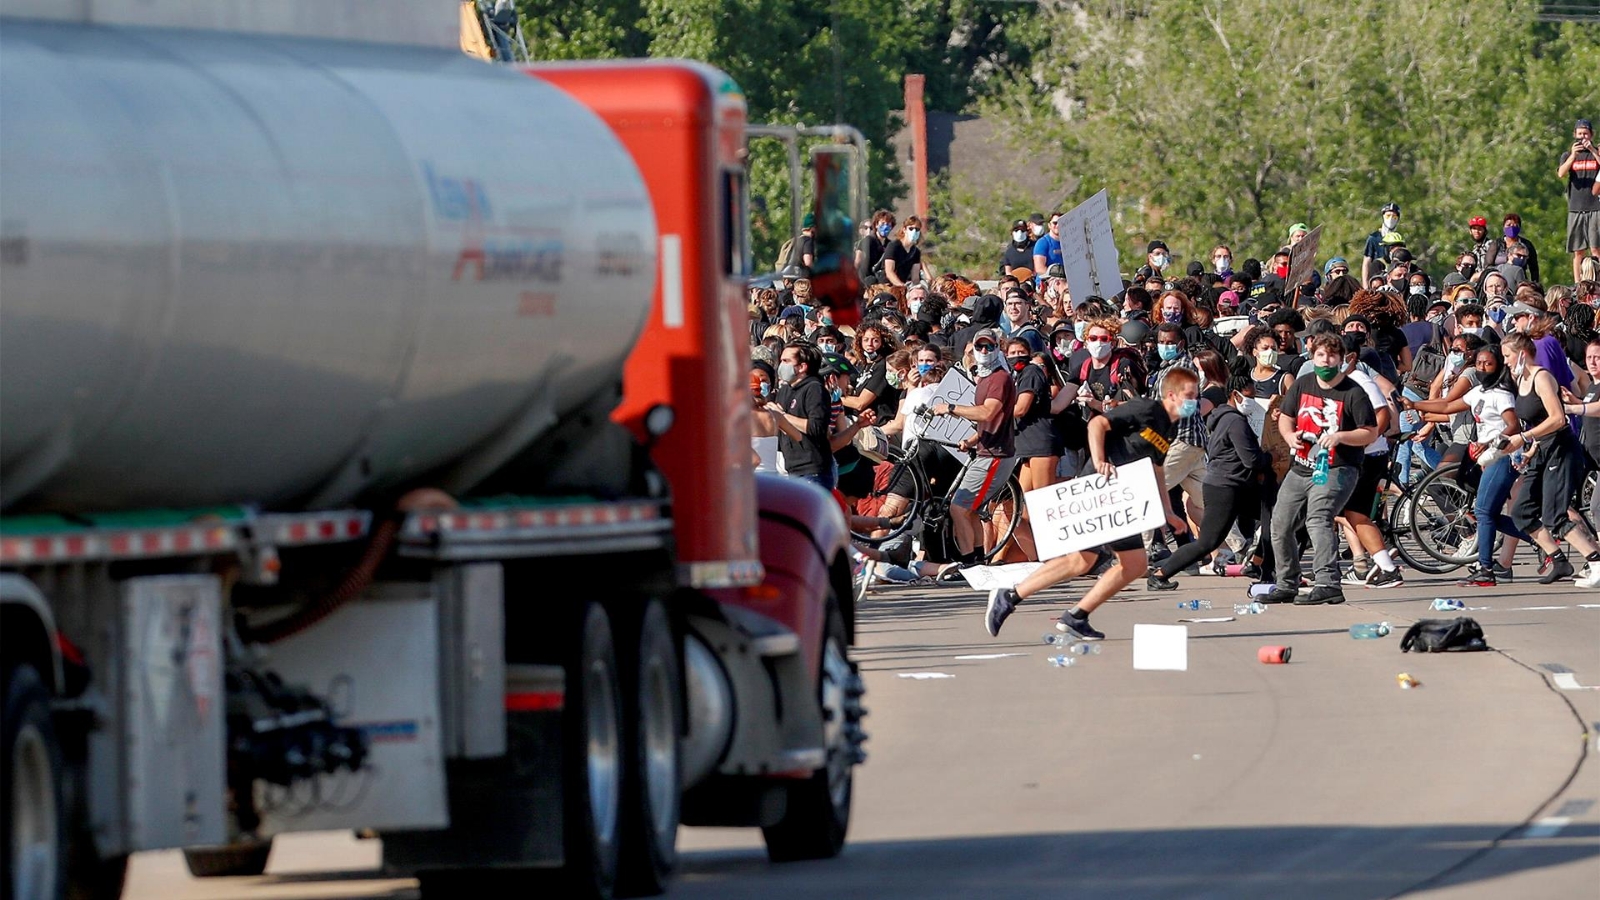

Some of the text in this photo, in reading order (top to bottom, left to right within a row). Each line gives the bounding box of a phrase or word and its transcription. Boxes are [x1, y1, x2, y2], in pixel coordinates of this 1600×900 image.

[1046, 487, 1135, 522] REQUIRES
[1056, 474, 1118, 500] PEACE
[1058, 500, 1149, 541] JUSTICE!
